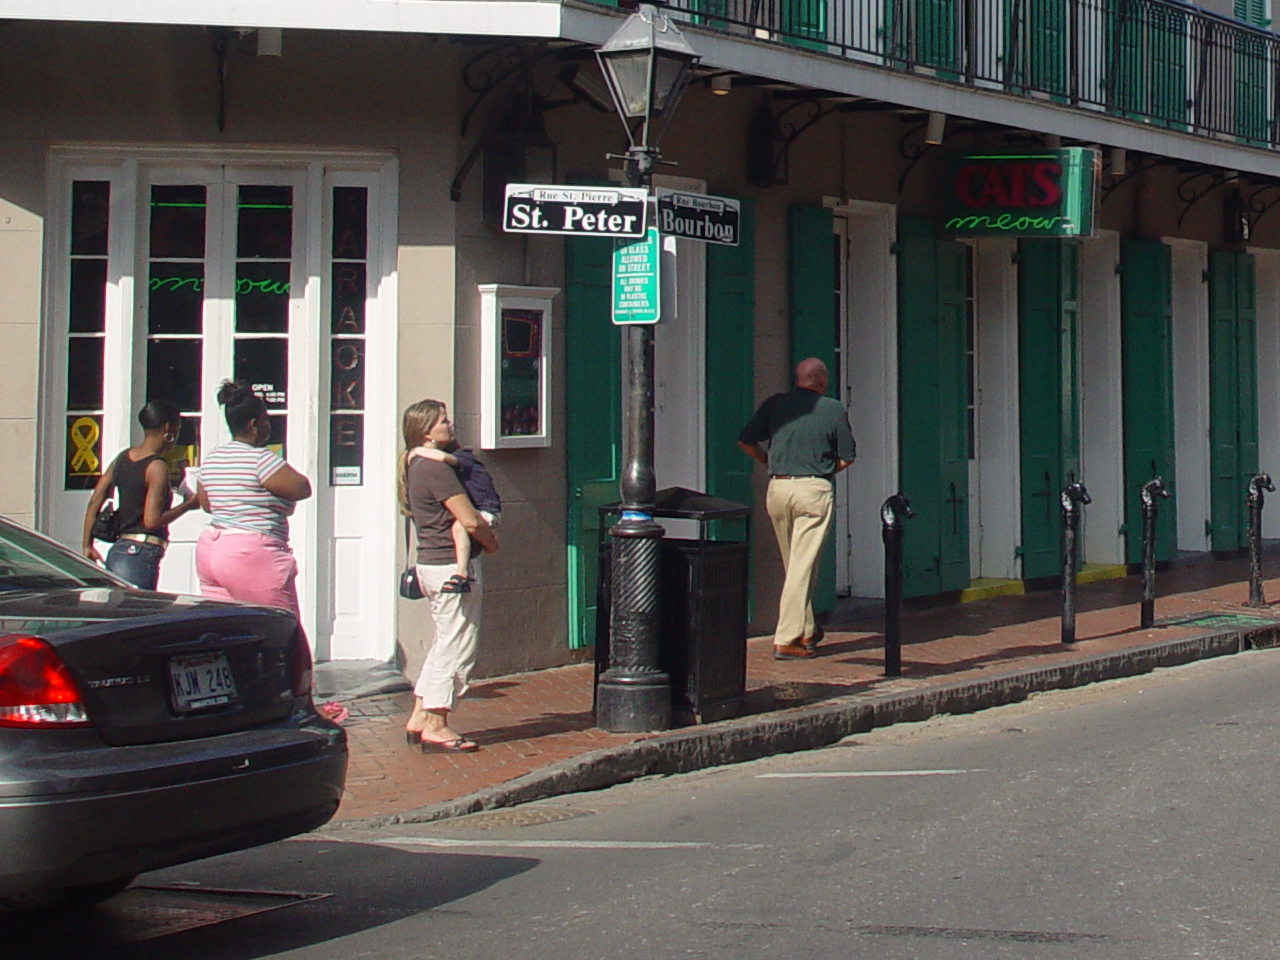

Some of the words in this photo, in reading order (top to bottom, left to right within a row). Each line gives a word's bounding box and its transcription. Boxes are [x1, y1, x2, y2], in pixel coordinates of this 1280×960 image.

[539, 190, 559, 200] Rue
[562, 191, 577, 201] St.
[581, 192, 613, 202] Pierre
[676, 196, 690, 206] Rue
[693, 198, 721, 211] Bourbon
[511, 203, 549, 229] St.
[562, 205, 637, 233] Peter
[661, 208, 734, 241] Bourbon
[945, 213, 1070, 230] meow
[251, 384, 274, 392] OPEN
